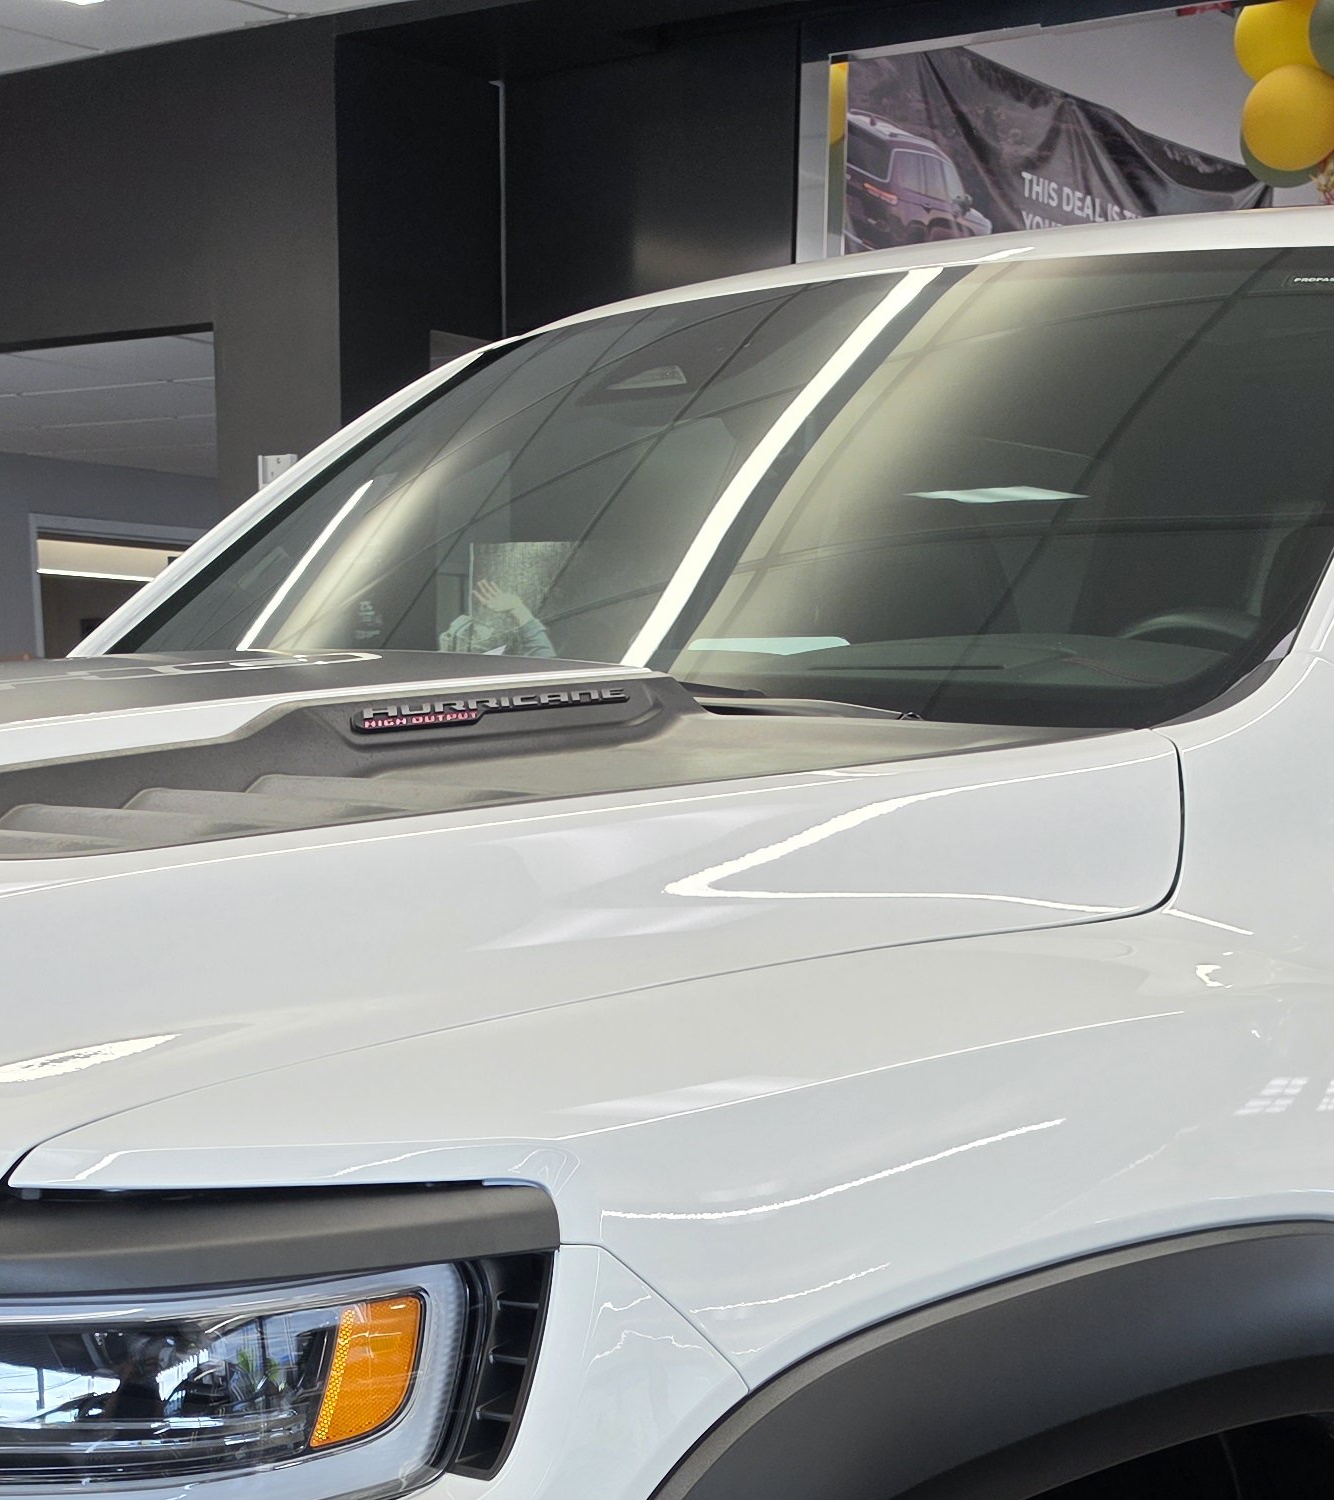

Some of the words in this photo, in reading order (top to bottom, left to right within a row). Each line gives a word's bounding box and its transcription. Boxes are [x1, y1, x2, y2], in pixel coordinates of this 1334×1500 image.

[1021, 171, 1058, 207] THIS
[1062, 187, 1105, 222] DEAL
[362, 687, 628, 719] HURRICANE
[364, 716, 408, 729] HIGH
[410, 710, 479, 726] OUTPUT
